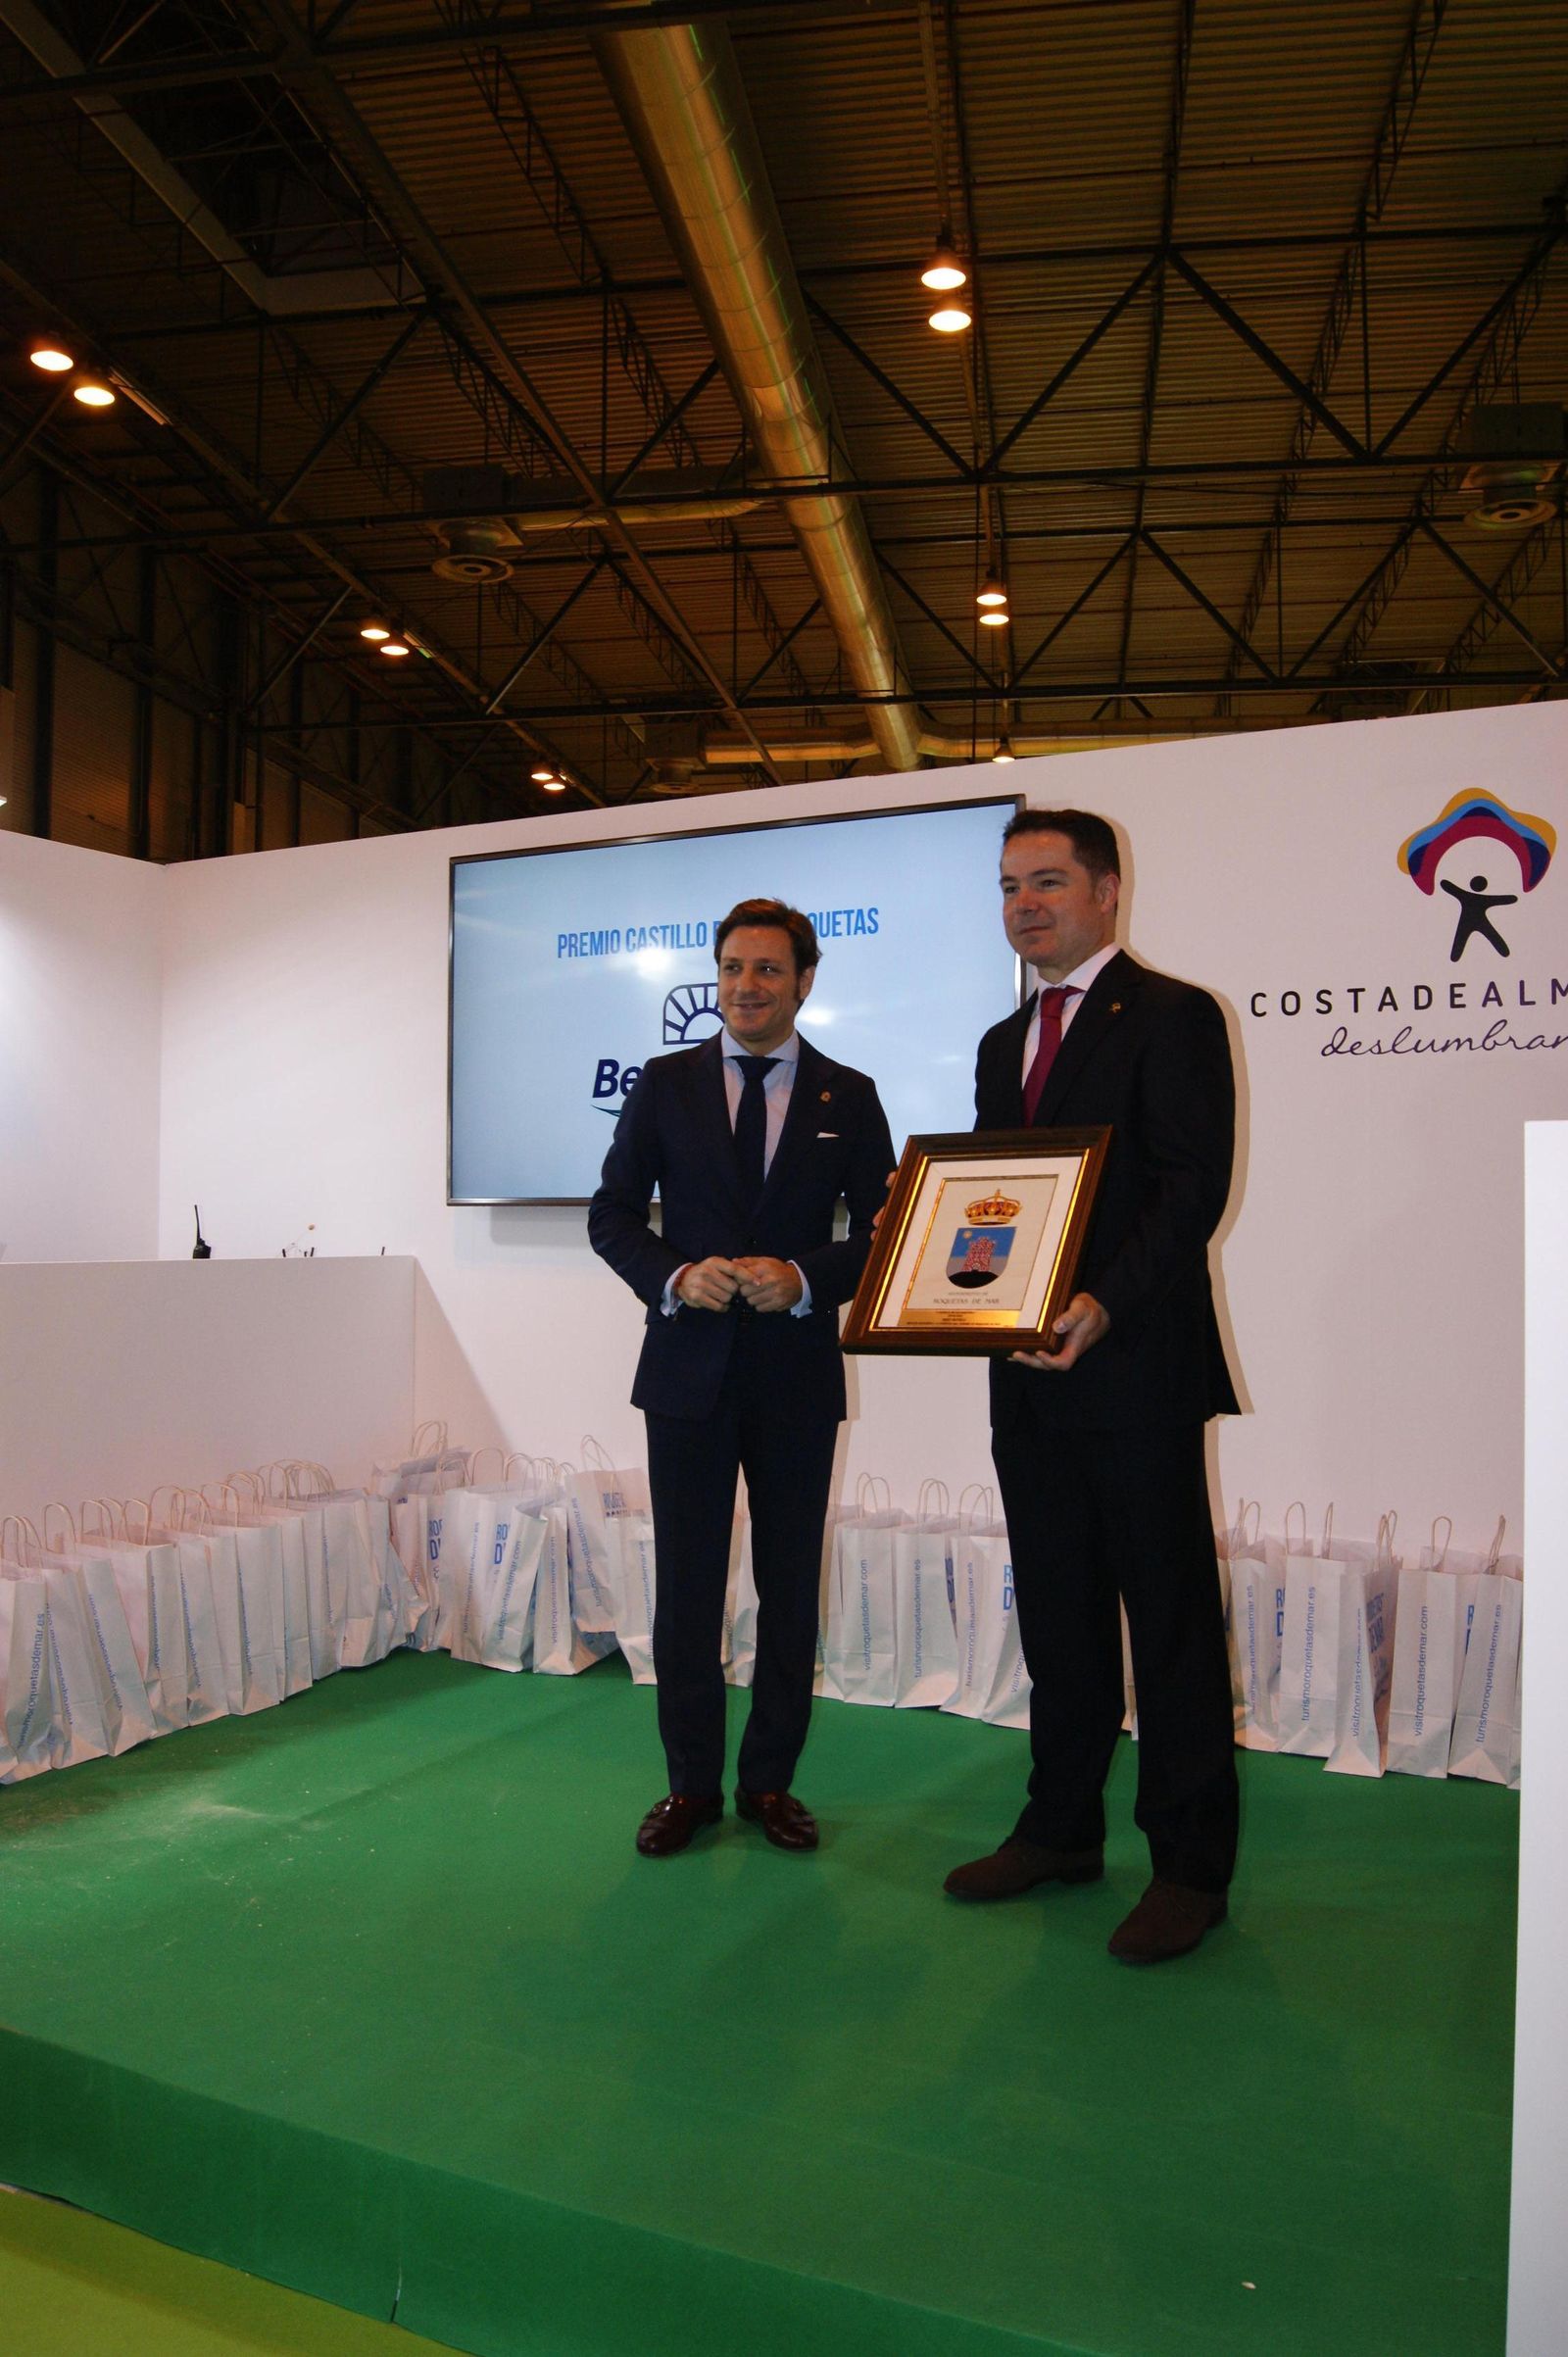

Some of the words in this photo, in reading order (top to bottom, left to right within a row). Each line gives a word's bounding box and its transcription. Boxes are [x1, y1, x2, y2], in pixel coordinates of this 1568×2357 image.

[558, 930, 620, 958] PREMIO
[625, 922, 707, 953] CASTILLO
[1301, 1586, 1316, 1722] turismoroquetasdemar.es
[1414, 1605, 1428, 1737] visitroquetasdemar.com
